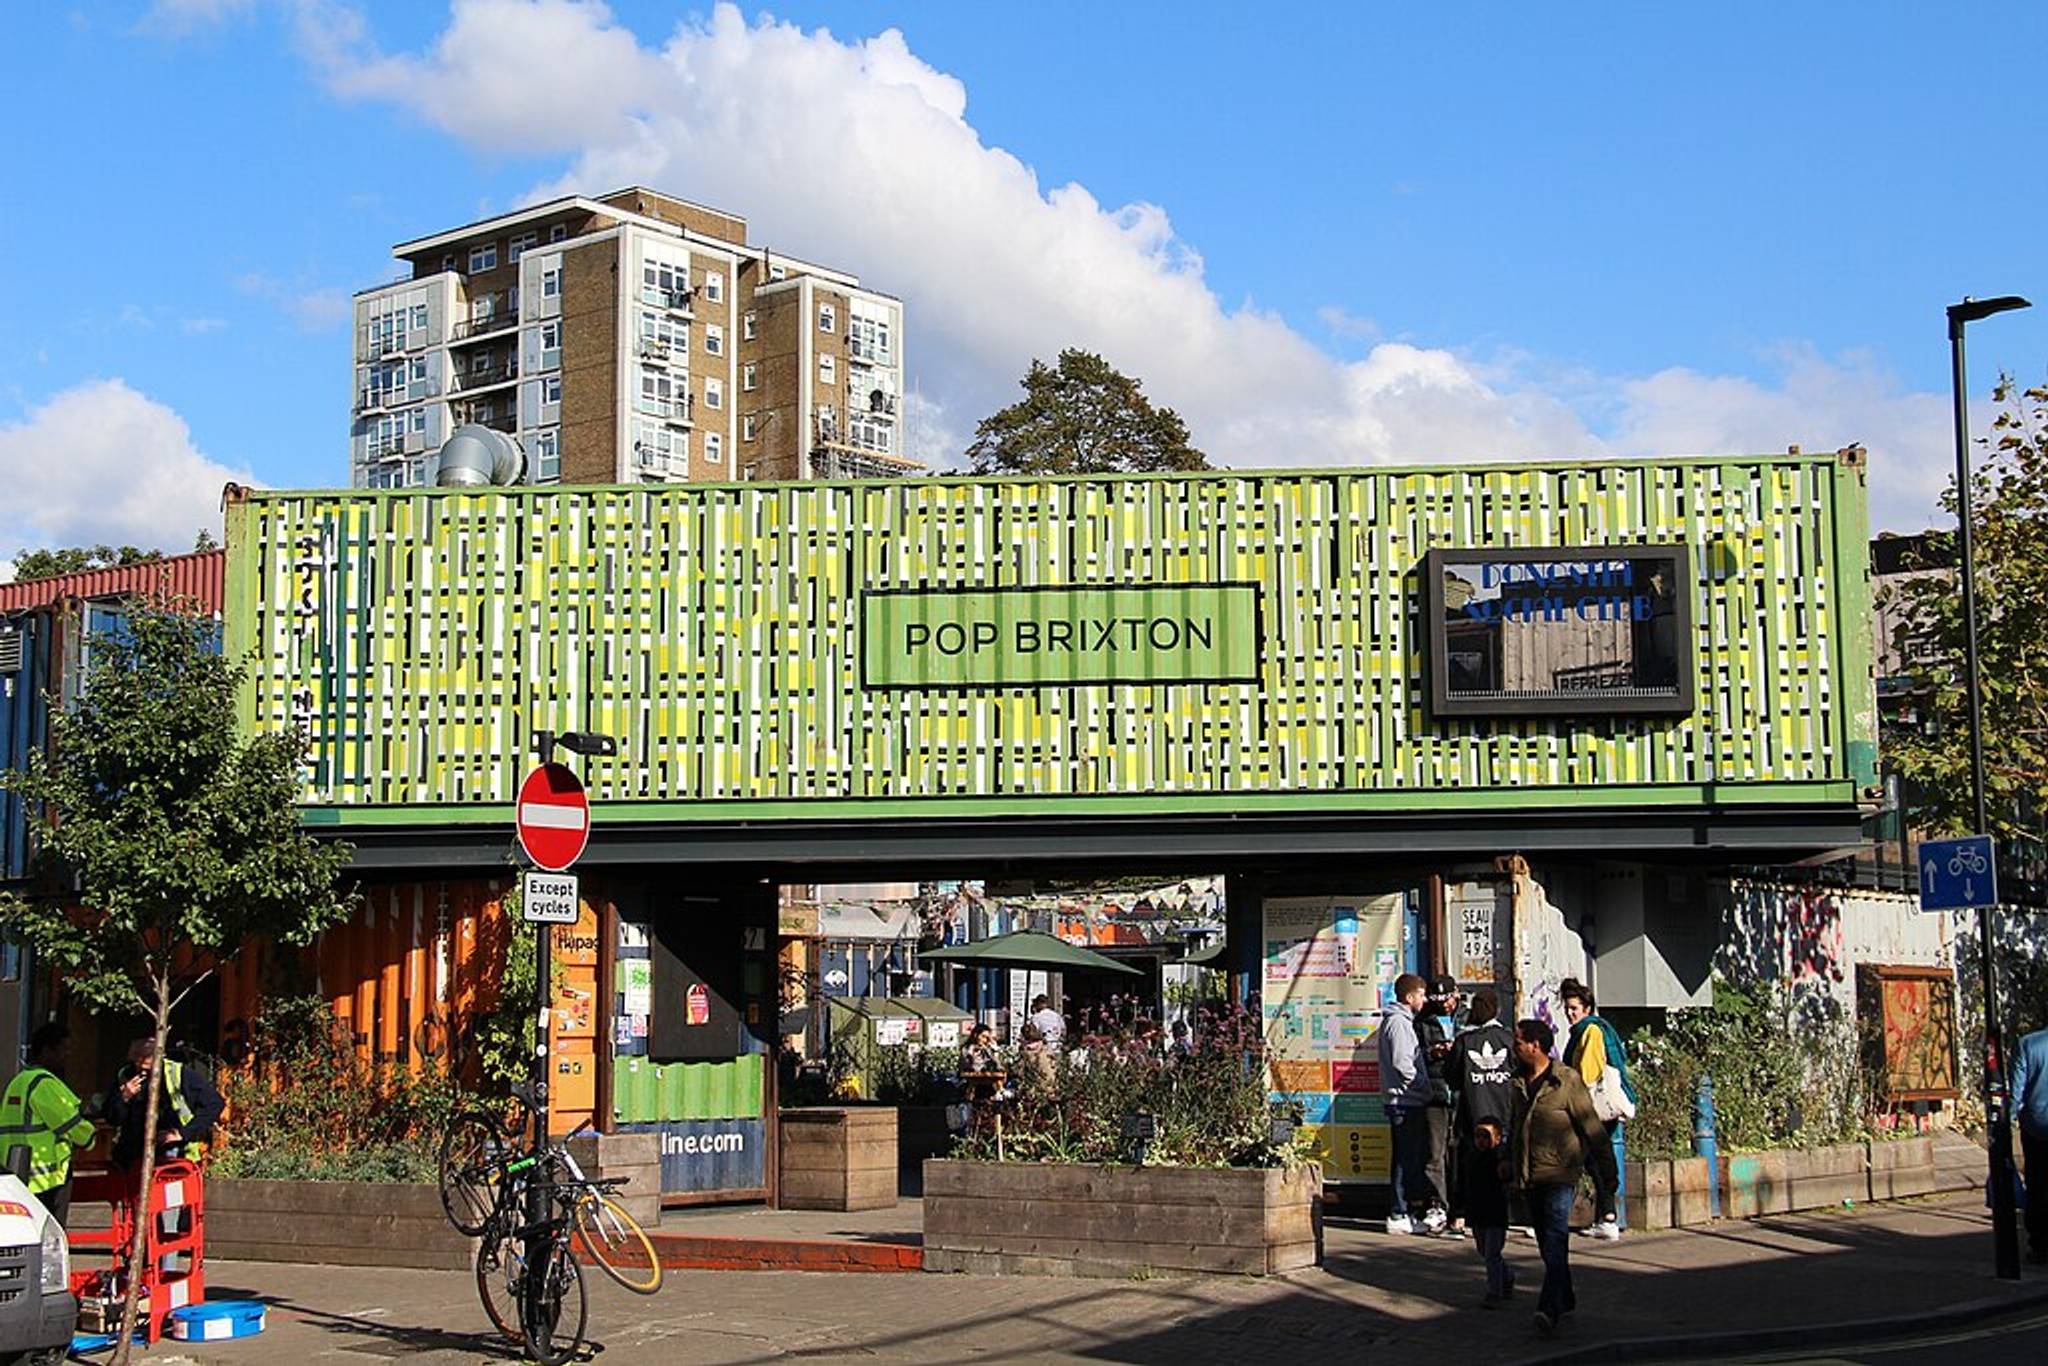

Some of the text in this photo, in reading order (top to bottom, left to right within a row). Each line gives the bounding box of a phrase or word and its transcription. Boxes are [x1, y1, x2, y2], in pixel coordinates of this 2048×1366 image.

[905, 617, 1212, 655] POP BRIXTON
[529, 880, 574, 898] Except
[531, 899, 572, 916] cycles
[1462, 909, 1489, 924] SEAU
[1464, 942, 1490, 956] 496
[661, 1131, 744, 1155] line.com
